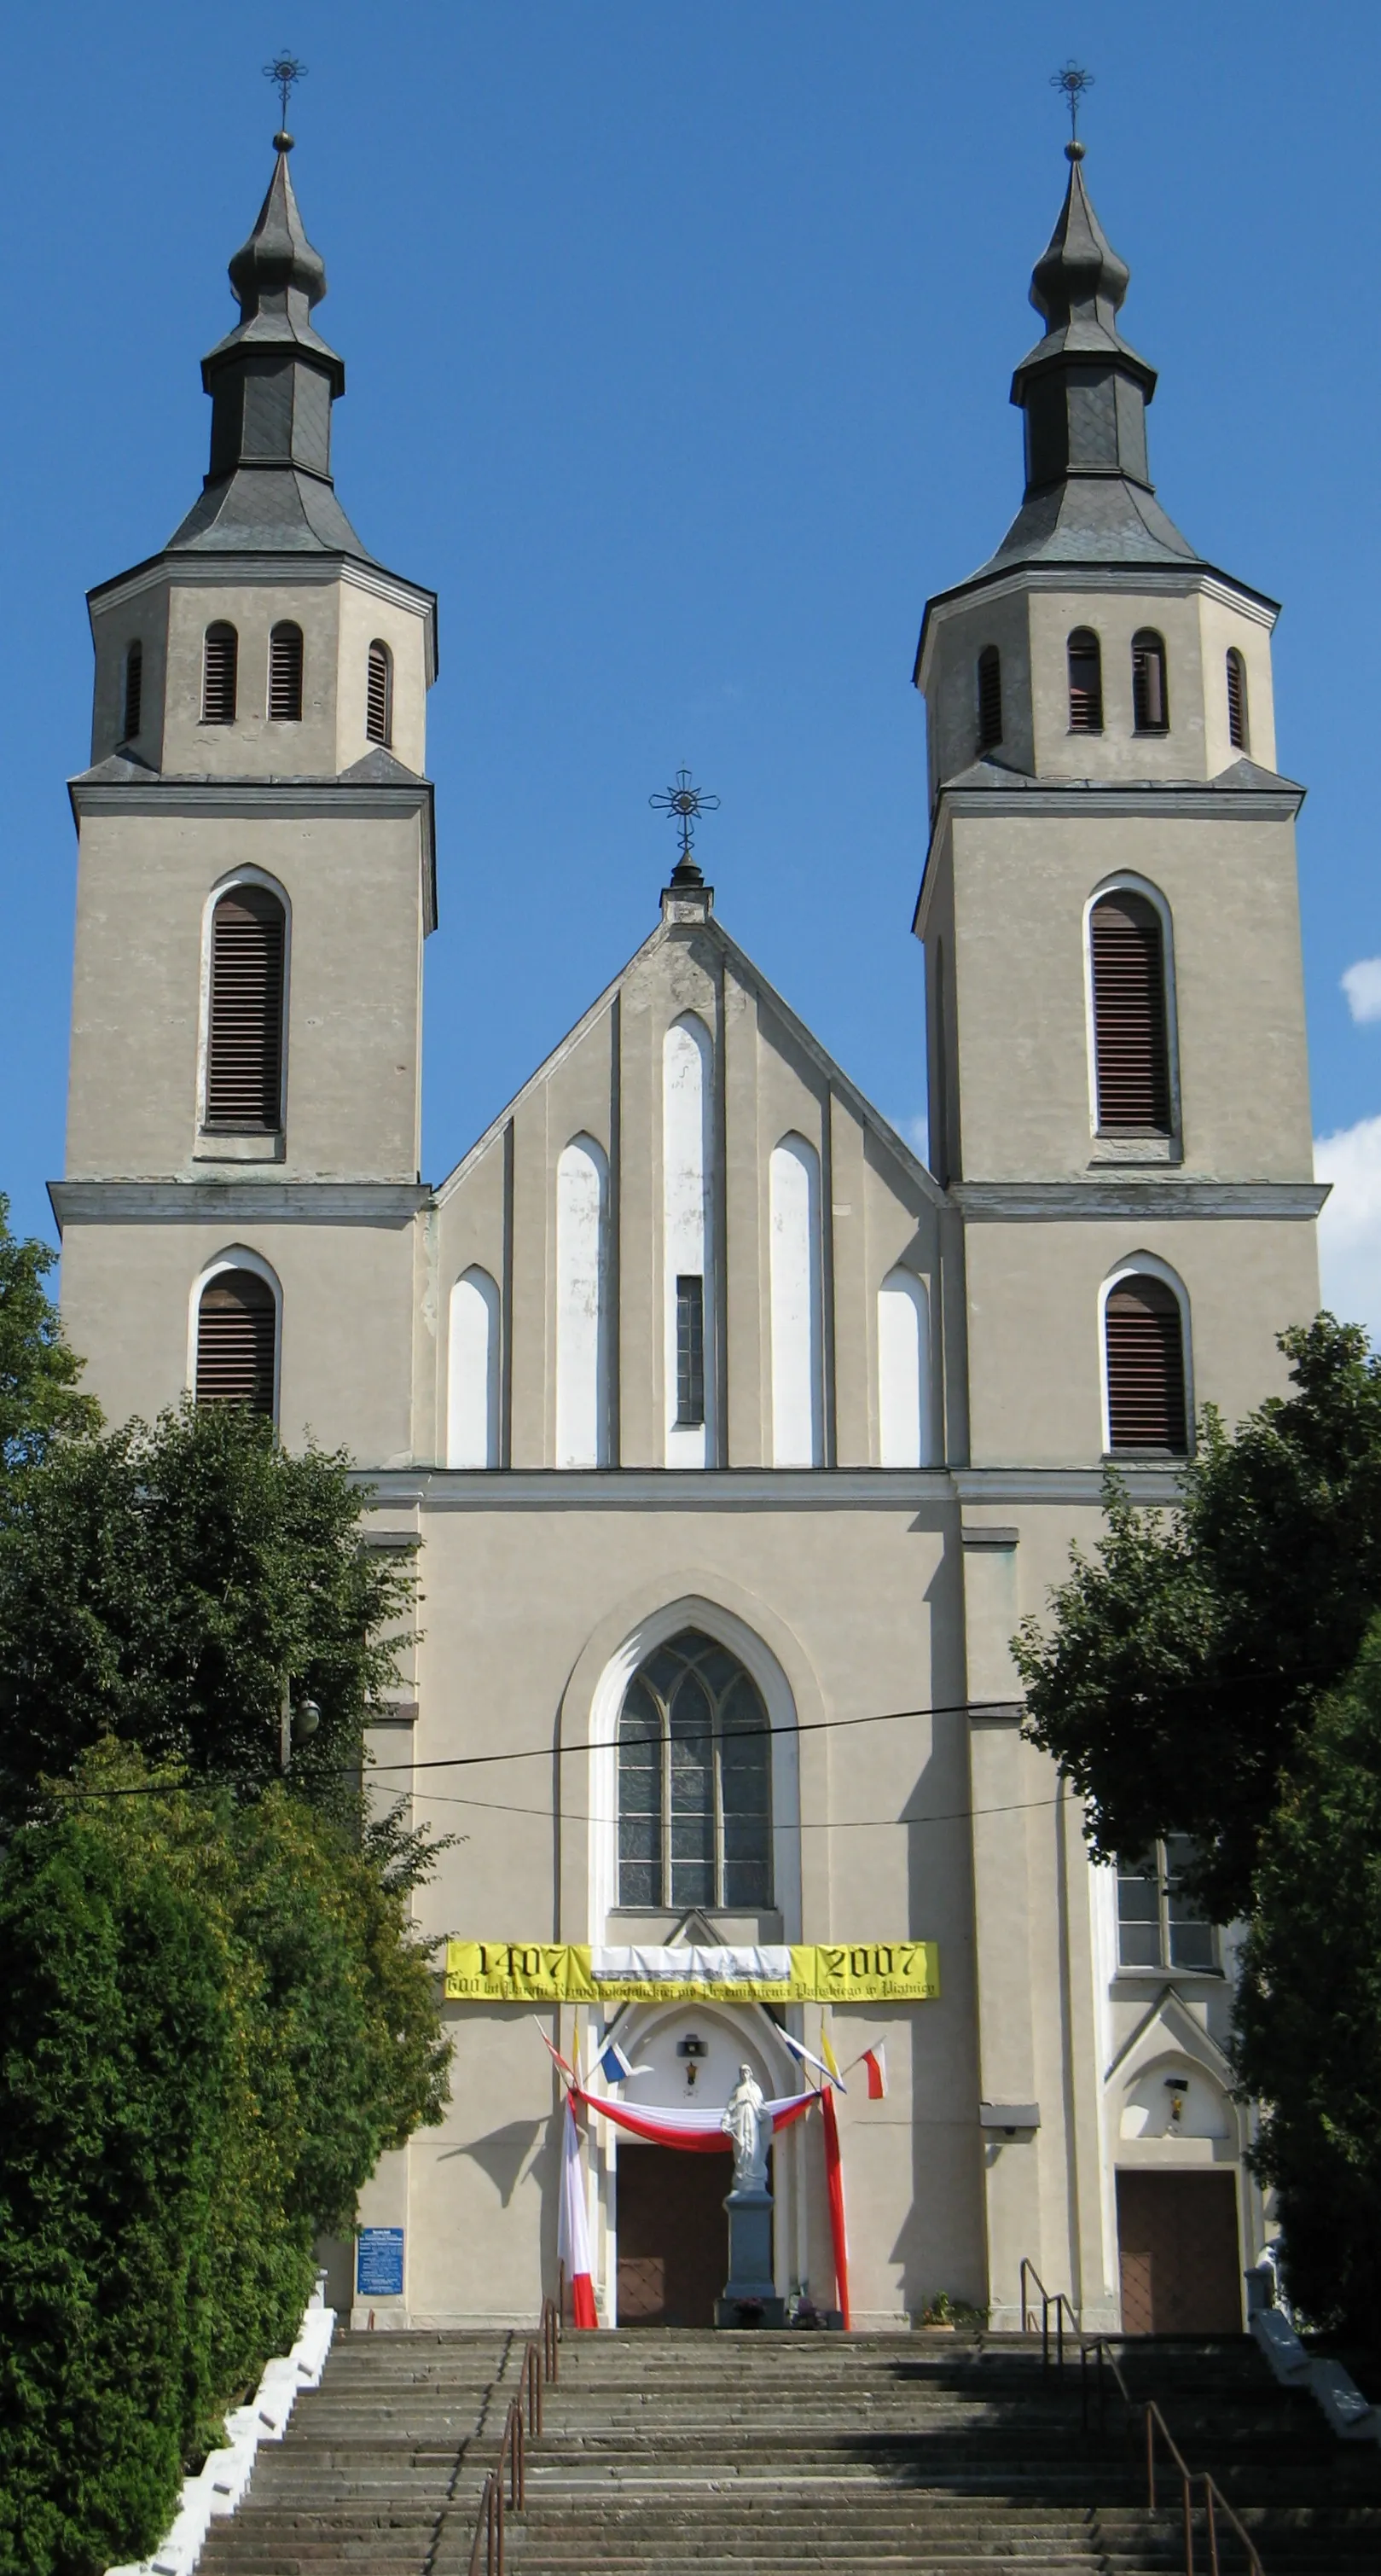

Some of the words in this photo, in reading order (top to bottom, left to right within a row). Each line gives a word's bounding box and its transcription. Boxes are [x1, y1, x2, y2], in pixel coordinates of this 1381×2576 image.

[475, 1944, 567, 1977] 1407
[826, 1944, 918, 1978] 2007
[448, 1977, 479, 1992] 600
[485, 1983, 499, 1995] lat
[866, 1985, 877, 1996] w
